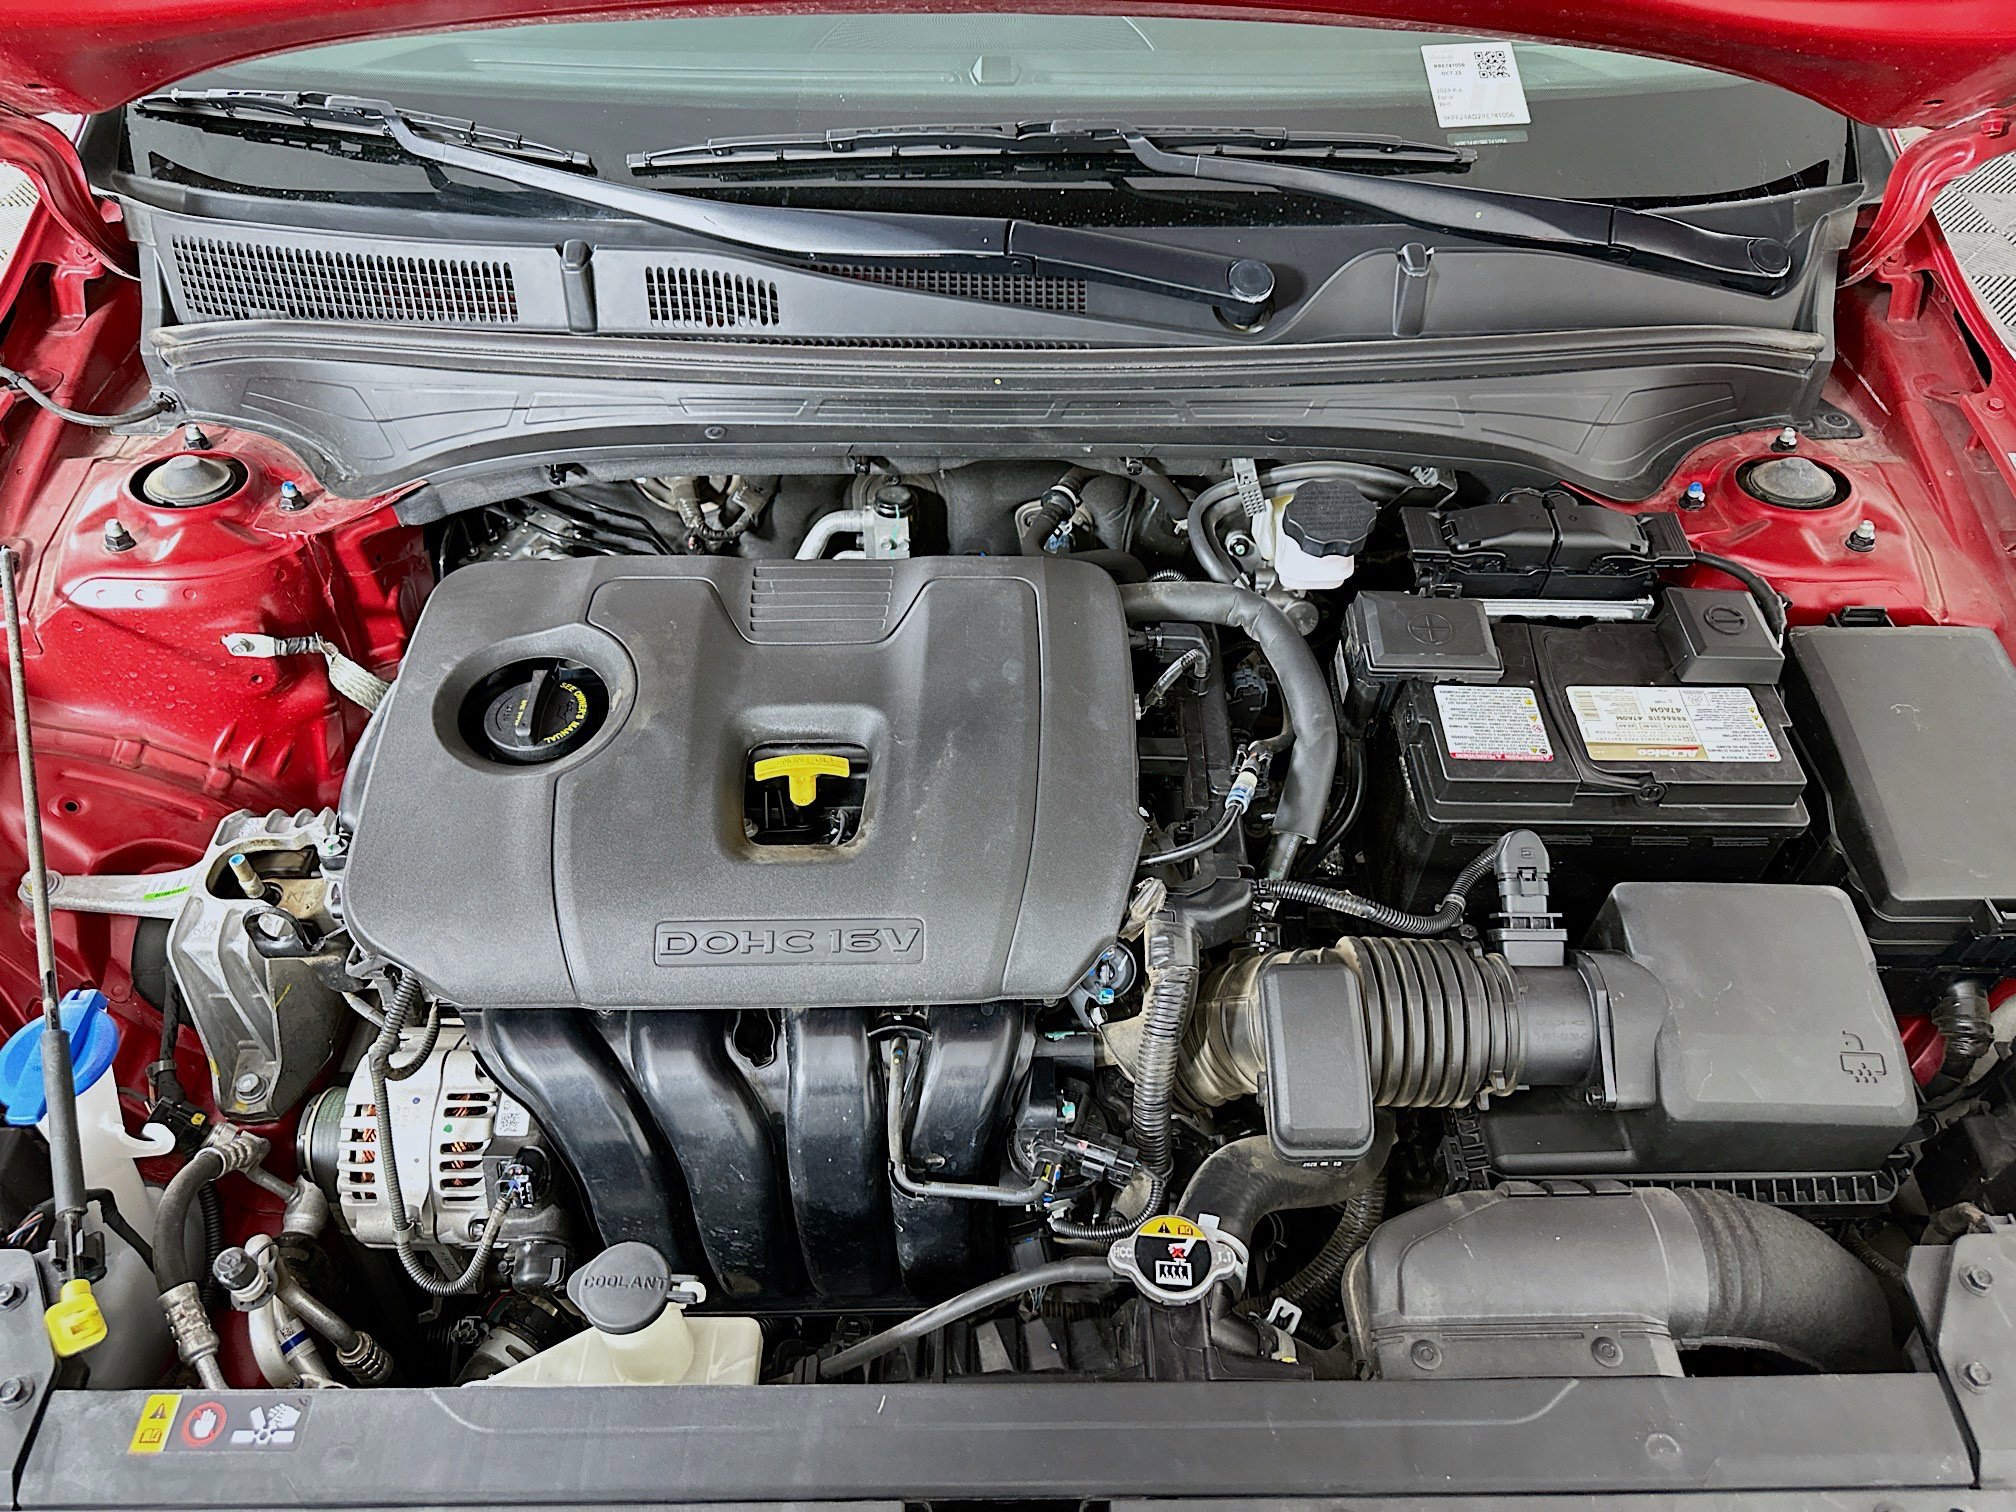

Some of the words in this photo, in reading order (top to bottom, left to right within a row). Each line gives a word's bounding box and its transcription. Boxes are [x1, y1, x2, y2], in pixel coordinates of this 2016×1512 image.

[560, 682, 577, 693] SEE
[543, 720, 580, 743] MANUAL
[660, 930, 814, 956] DOHC
[829, 928, 920, 953] 16V
[584, 1274, 669, 1290] COOLANT
